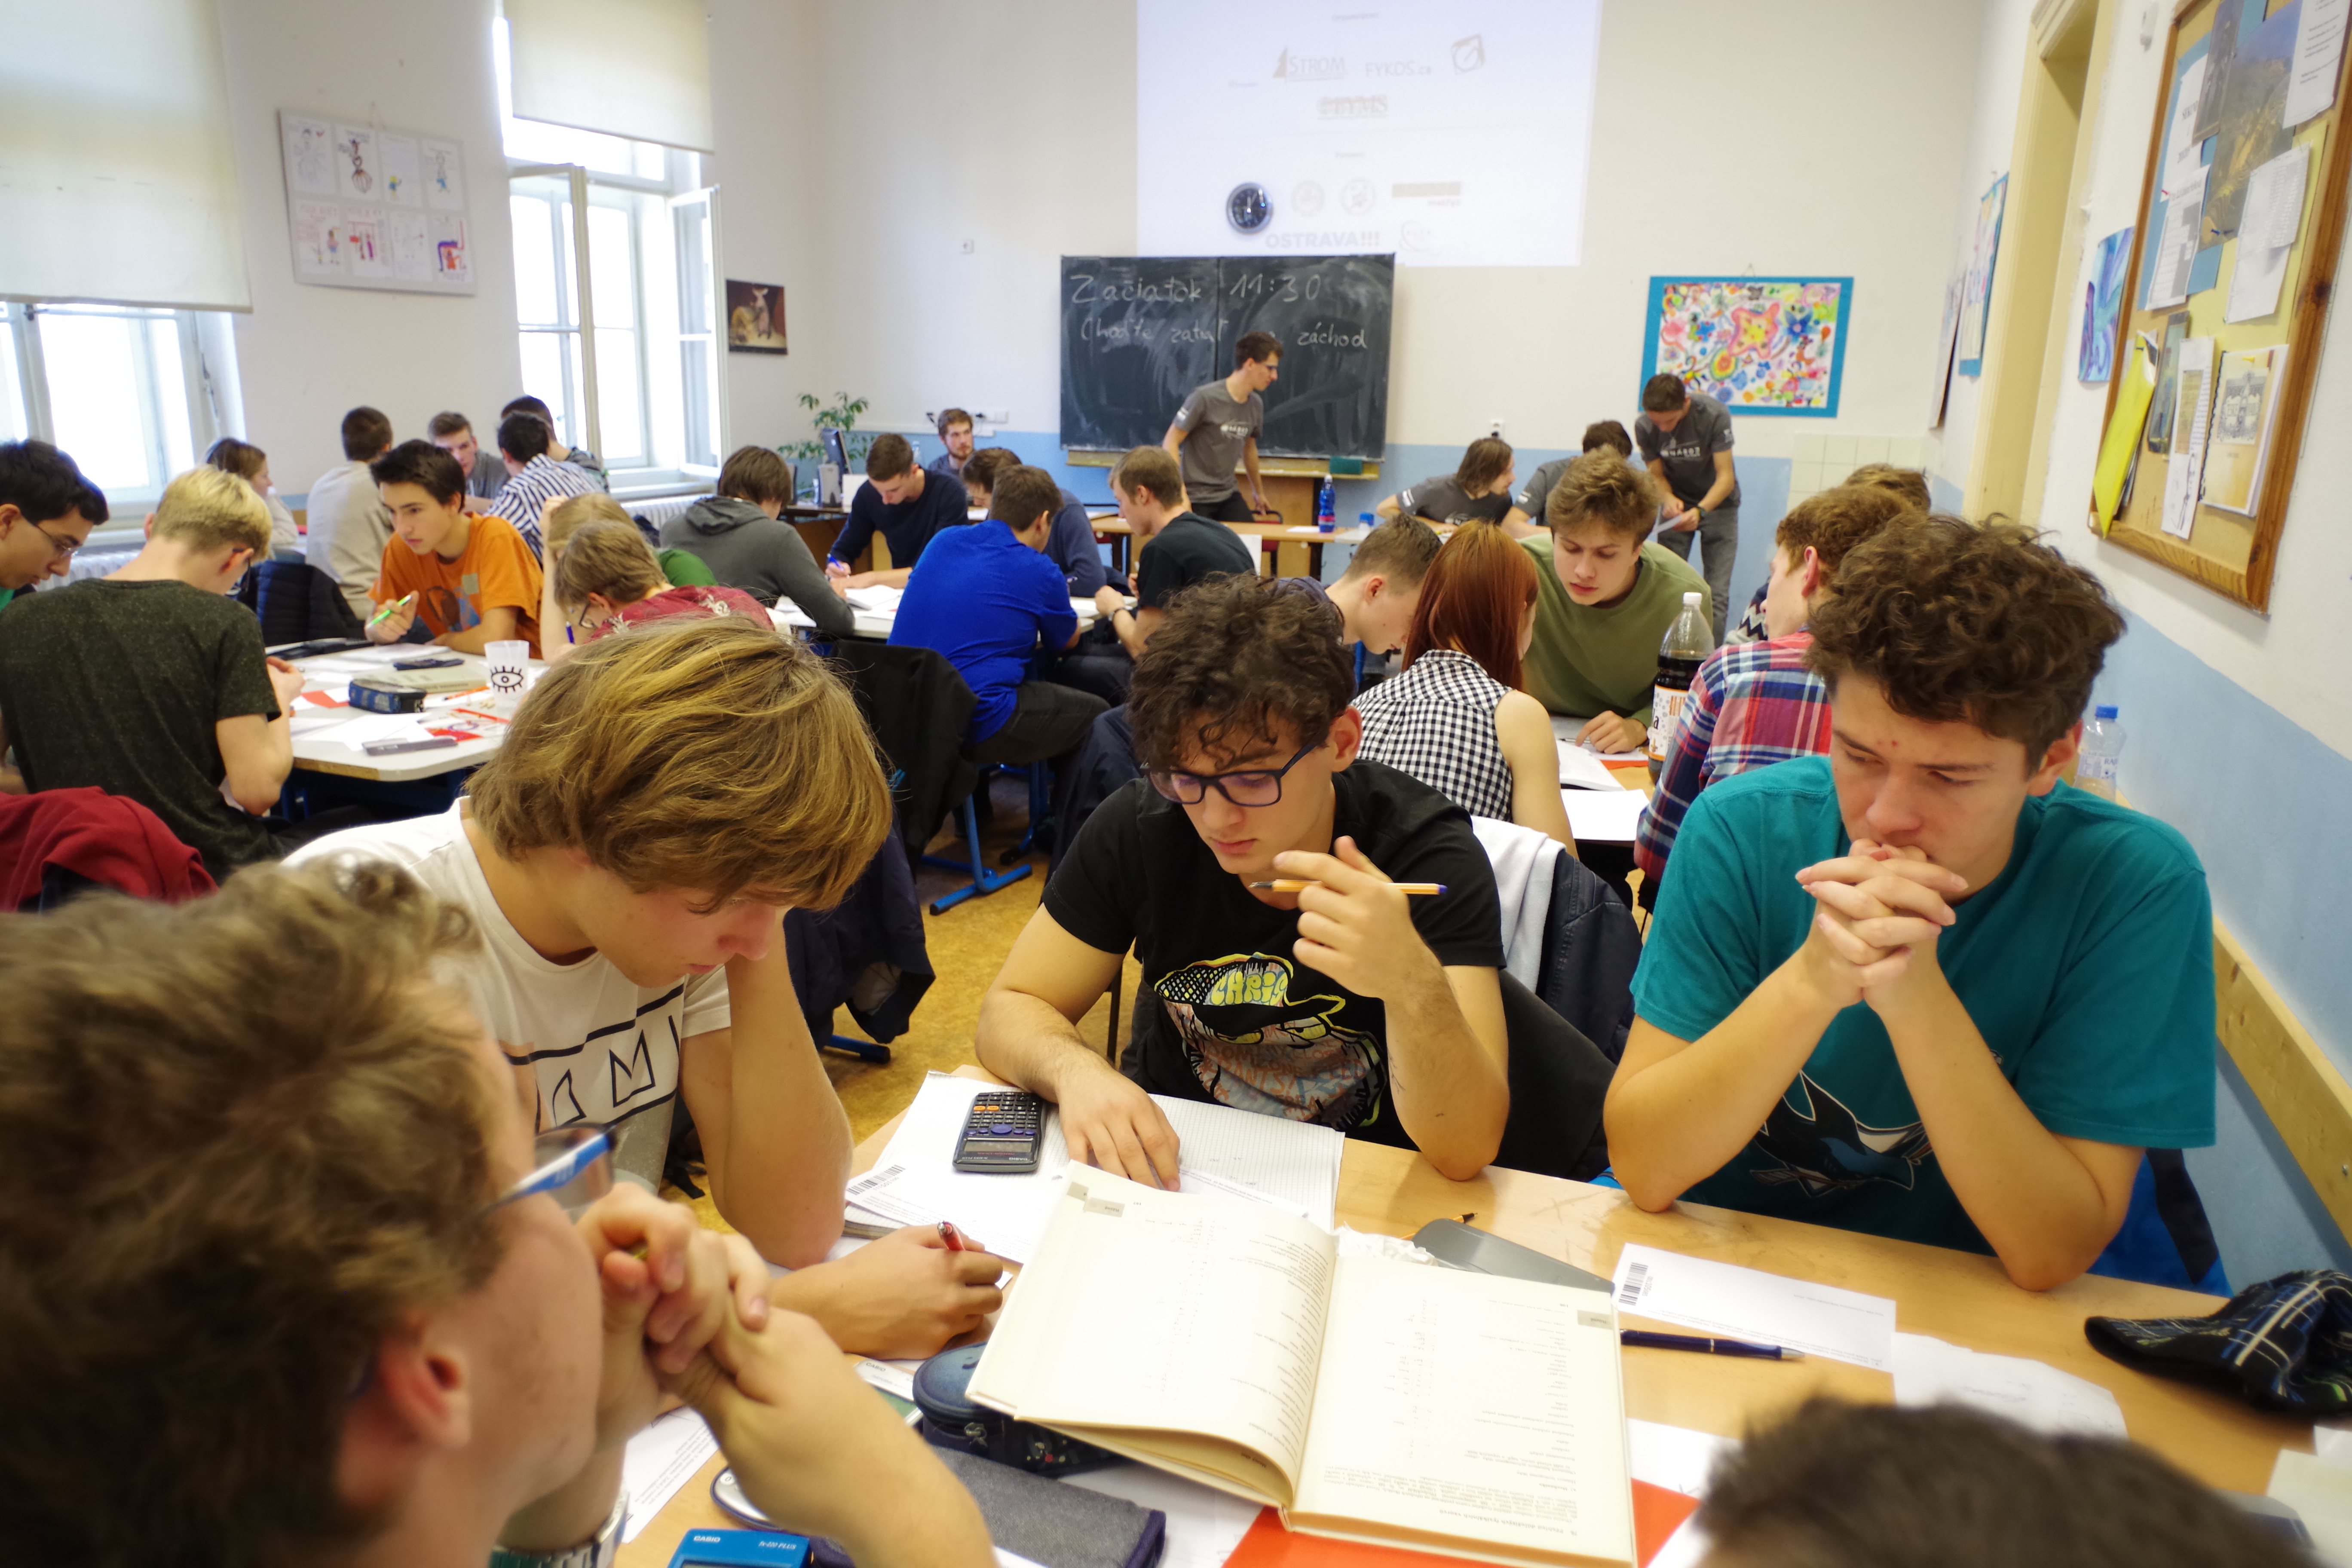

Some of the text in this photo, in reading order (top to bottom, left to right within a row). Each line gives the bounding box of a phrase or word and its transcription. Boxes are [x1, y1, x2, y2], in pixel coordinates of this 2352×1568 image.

[1289, 56, 1346, 74] STROM
[1229, 273, 1321, 303] 11:30
[1298, 322, 1368, 349] záchod
[866, 1362, 886, 1372] CASIO
